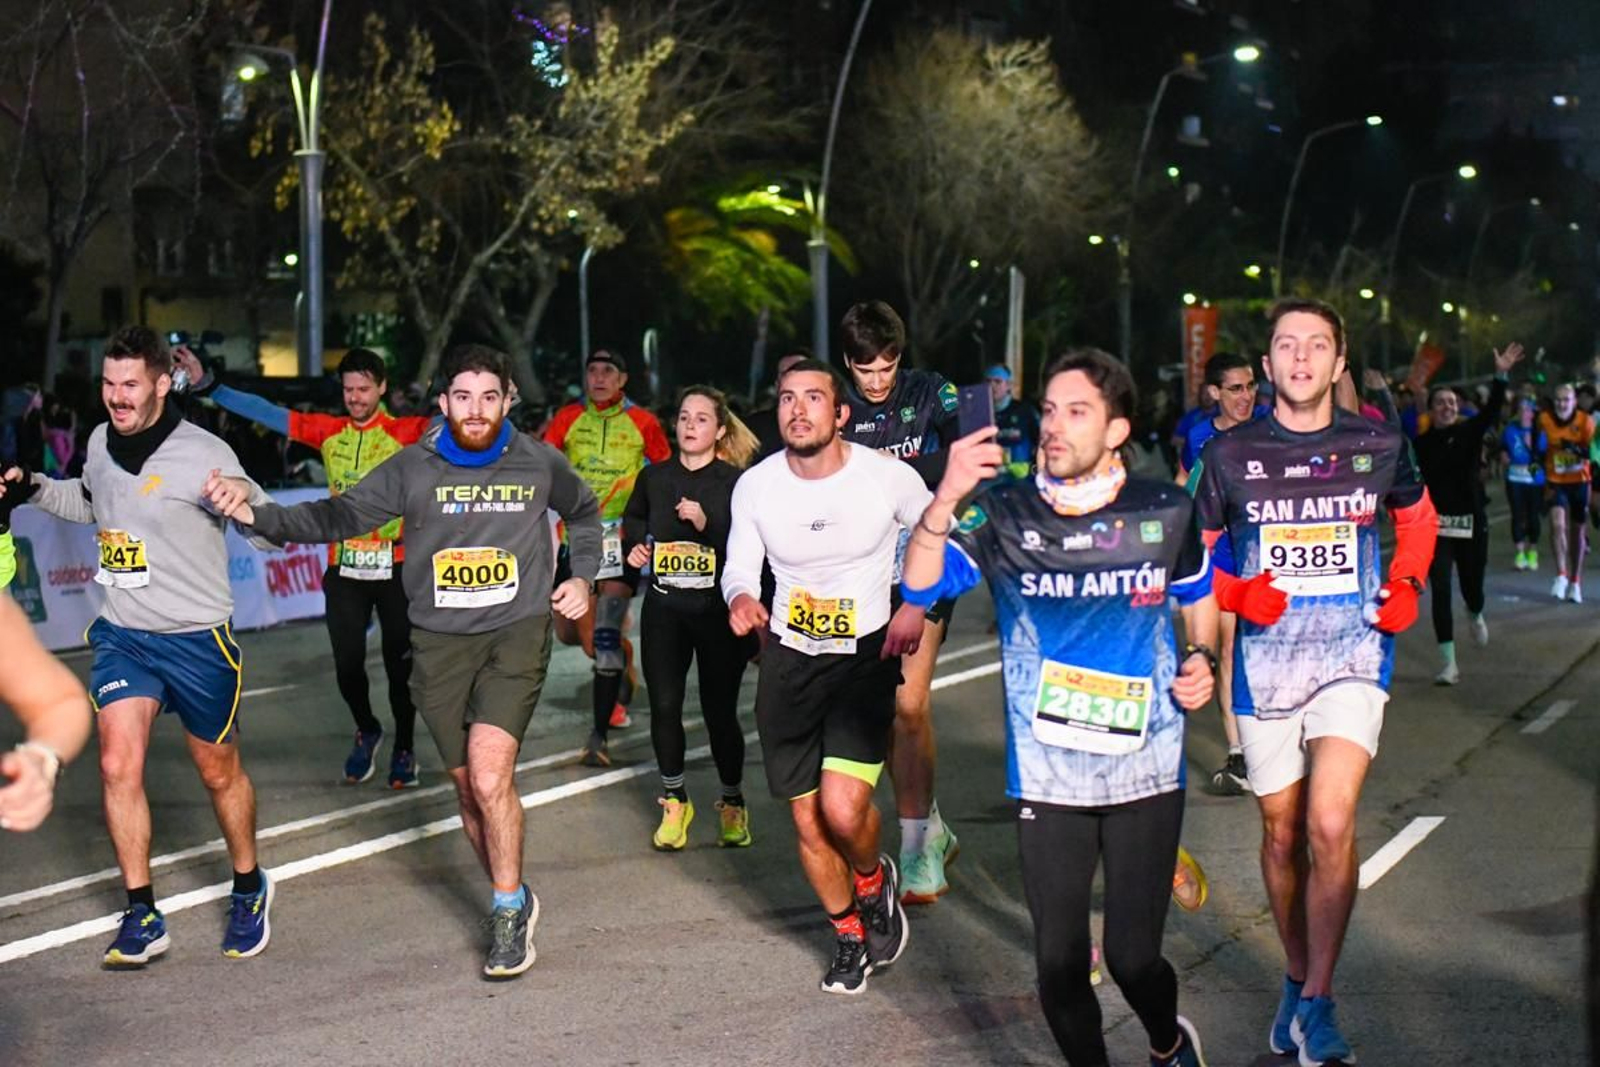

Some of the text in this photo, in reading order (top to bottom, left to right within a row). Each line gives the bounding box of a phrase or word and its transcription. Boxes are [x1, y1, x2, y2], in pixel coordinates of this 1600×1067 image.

[1246, 487, 1378, 523] SAN ANTÓN
[658, 555, 710, 572] 4068
[1270, 543, 1348, 569] 9385
[441, 562, 509, 585] 4000
[1020, 562, 1167, 597] SAN ANTÓN
[1043, 685, 1140, 729] 2830
